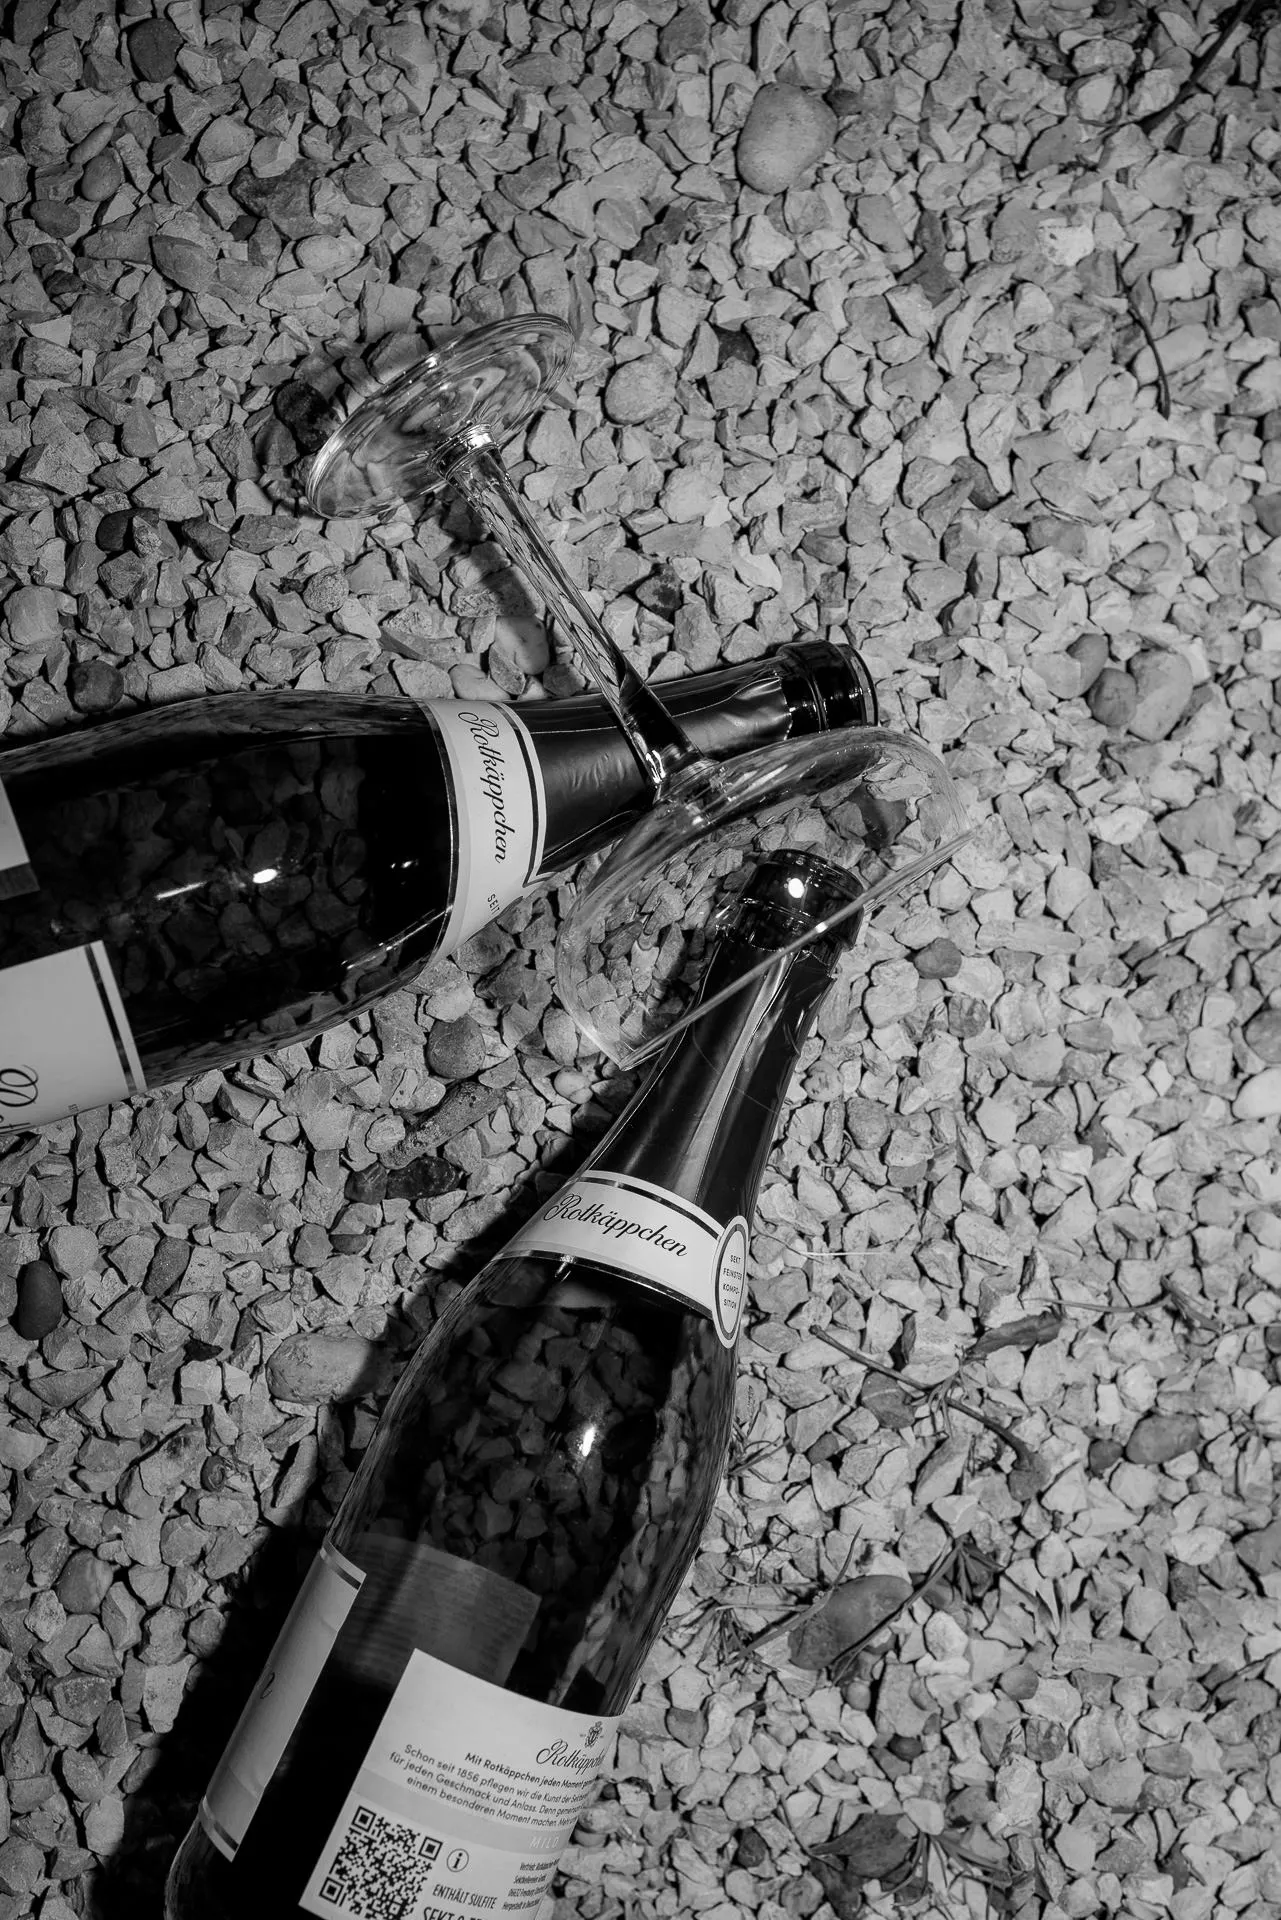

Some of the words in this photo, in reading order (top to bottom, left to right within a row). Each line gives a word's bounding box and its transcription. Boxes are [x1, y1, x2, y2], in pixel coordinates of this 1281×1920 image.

[457, 712, 515, 864] Rotkäppchen
[543, 1193, 688, 1257] Rotkäppchen
[730, 1254, 741, 1264] SEKT
[723, 1298, 737, 1309] SITION
[389, 1752, 405, 1765] für
[403, 1760, 434, 1779] jeden
[436, 1773, 491, 1801] Geschmack
[492, 1794, 511, 1807] und
[511, 1801, 537, 1813] Anlass.
[538, 1804, 556, 1815] Denn
[404, 1744, 435, 1765] Schon
[437, 1761, 455, 1773] seit
[457, 1767, 480, 1783] 1856
[480, 1777, 515, 1794] pflegen
[516, 1788, 530, 1799] wir
[530, 1791, 542, 1801] die
[464, 1752, 482, 1766] Mit
[483, 1759, 540, 1783] Rotkäppchen
[539, 1776, 560, 1787] jeden
[407, 1776, 437, 1795] einem
[439, 1788, 495, 1816] besonderen
[496, 1808, 531, 1824] Moment
[432, 1884, 470, 1904] ENTHÄLT
[468, 1893, 498, 1910] SULFITE
